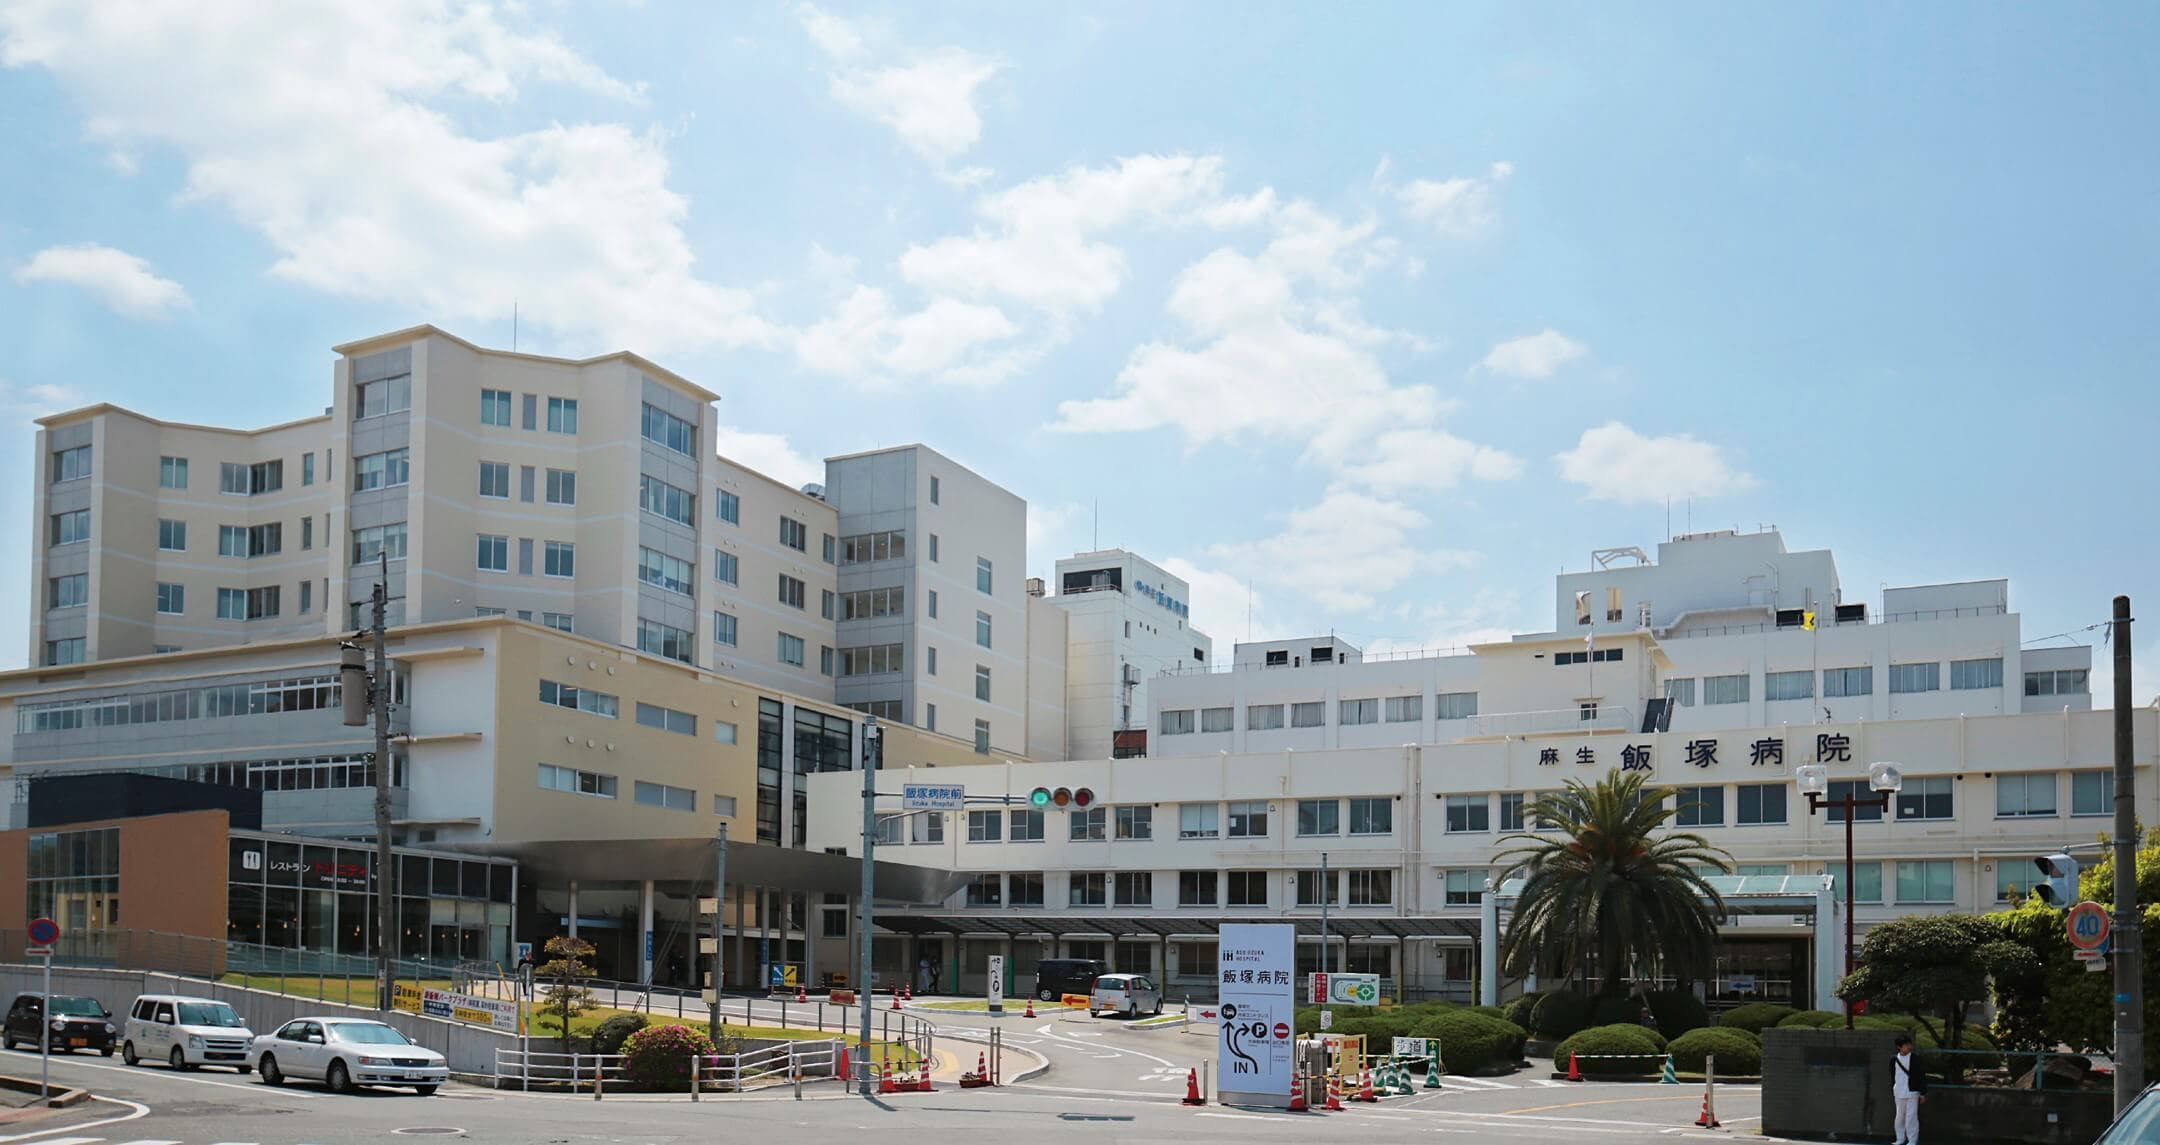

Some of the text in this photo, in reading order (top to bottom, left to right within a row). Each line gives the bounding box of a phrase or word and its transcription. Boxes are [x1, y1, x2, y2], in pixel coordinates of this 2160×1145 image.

[1539, 732, 1851, 771] 麻生 飯塚病院
[905, 787, 961, 800] 飯塚病院前
[270, 860, 311, 873] レストラン
[2077, 914, 2099, 935] 40
[1223, 970, 1289, 984] 飯塚病院
[1234, 1061, 1248, 1073] IN
